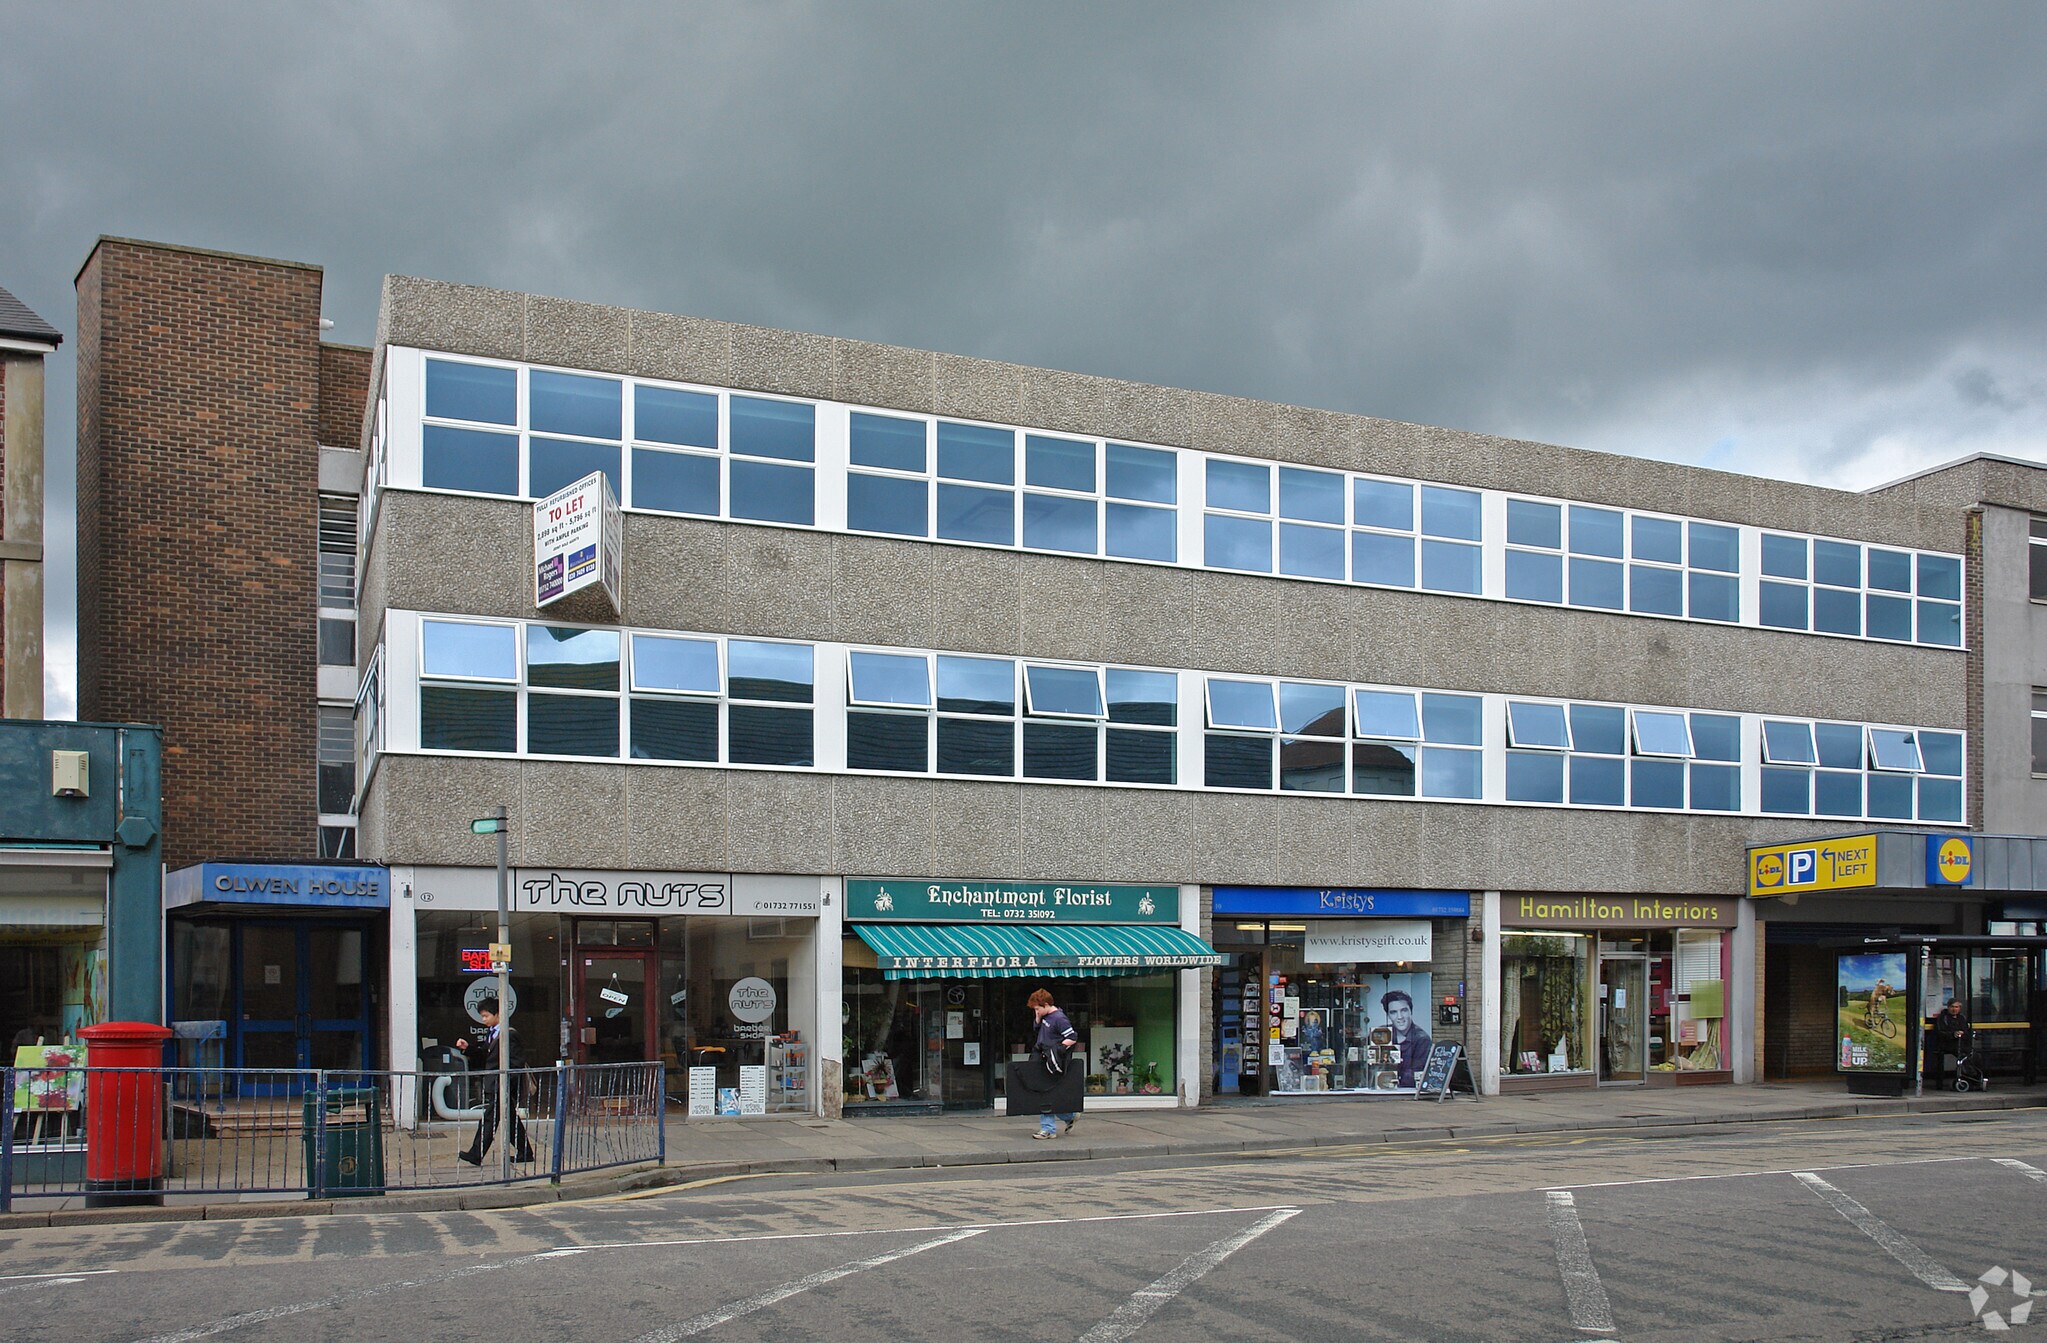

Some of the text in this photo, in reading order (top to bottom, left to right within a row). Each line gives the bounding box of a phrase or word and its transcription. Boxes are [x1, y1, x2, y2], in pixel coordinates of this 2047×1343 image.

[536, 478, 596, 512] FULLY REFURBISHED OFFICES
[549, 495, 584, 523] TO LET
[545, 522, 588, 546] WITH AMPLE PARKING
[544, 569, 558, 580] Rogers
[1838, 848, 1869, 861] NEXT
[1792, 854, 1813, 882] P
[1838, 864, 1868, 876] LEFT
[215, 875, 379, 897] OLWEN HOUSE
[927, 886, 1112, 907] Enchantment Florist
[1319, 891, 1375, 912] Kristys
[1520, 897, 1718, 920] Hamilton Interiors
[981, 909, 1055, 919] TEL: 0732 351092
[1310, 935, 1428, 948] www.kristysgift.co.uk
[893, 954, 1222, 968] INTERFLORA FLOWERS WORLDWIDE
[602, 993, 625, 1002] OPEN
